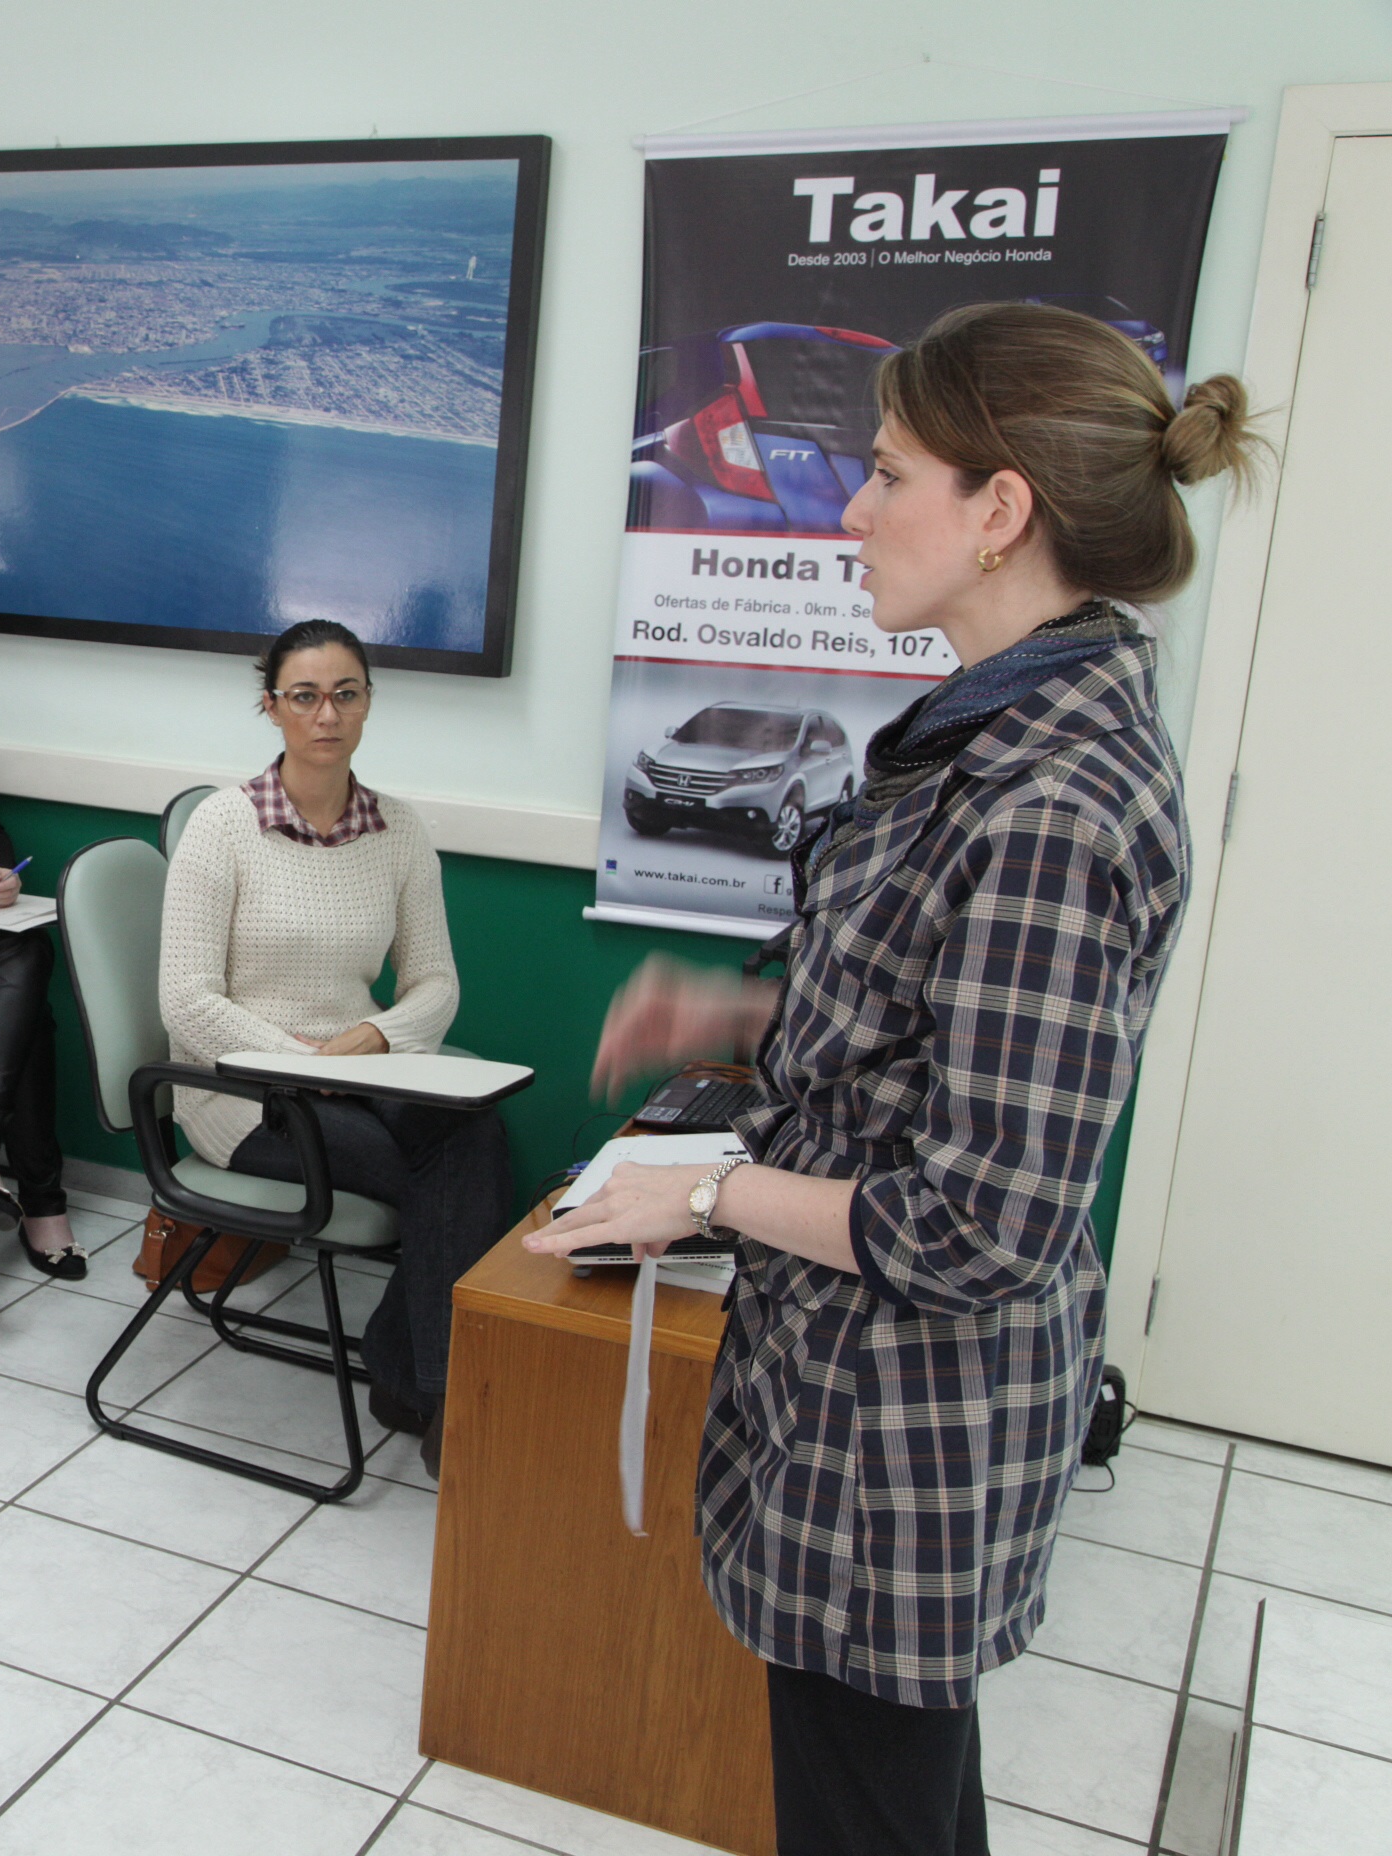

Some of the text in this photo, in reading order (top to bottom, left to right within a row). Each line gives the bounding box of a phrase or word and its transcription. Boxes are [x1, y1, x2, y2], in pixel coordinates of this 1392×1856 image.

[793, 168, 1061, 243] Takai
[788, 249, 1052, 266] Desde 2003 O Melhor Negócio Honda
[769, 449, 815, 462] FIT
[691, 548, 872, 582] Honda T
[654, 594, 707, 610] Ofertas
[711, 598, 730, 611] de
[734, 598, 791, 614] Fábrica
[851, 604, 871, 618] Se
[632, 620, 934, 658] Rod. Osvaldo Reis, 107
[634, 868, 747, 889] www.takai.com.br
[758, 903, 793, 917] Respe
